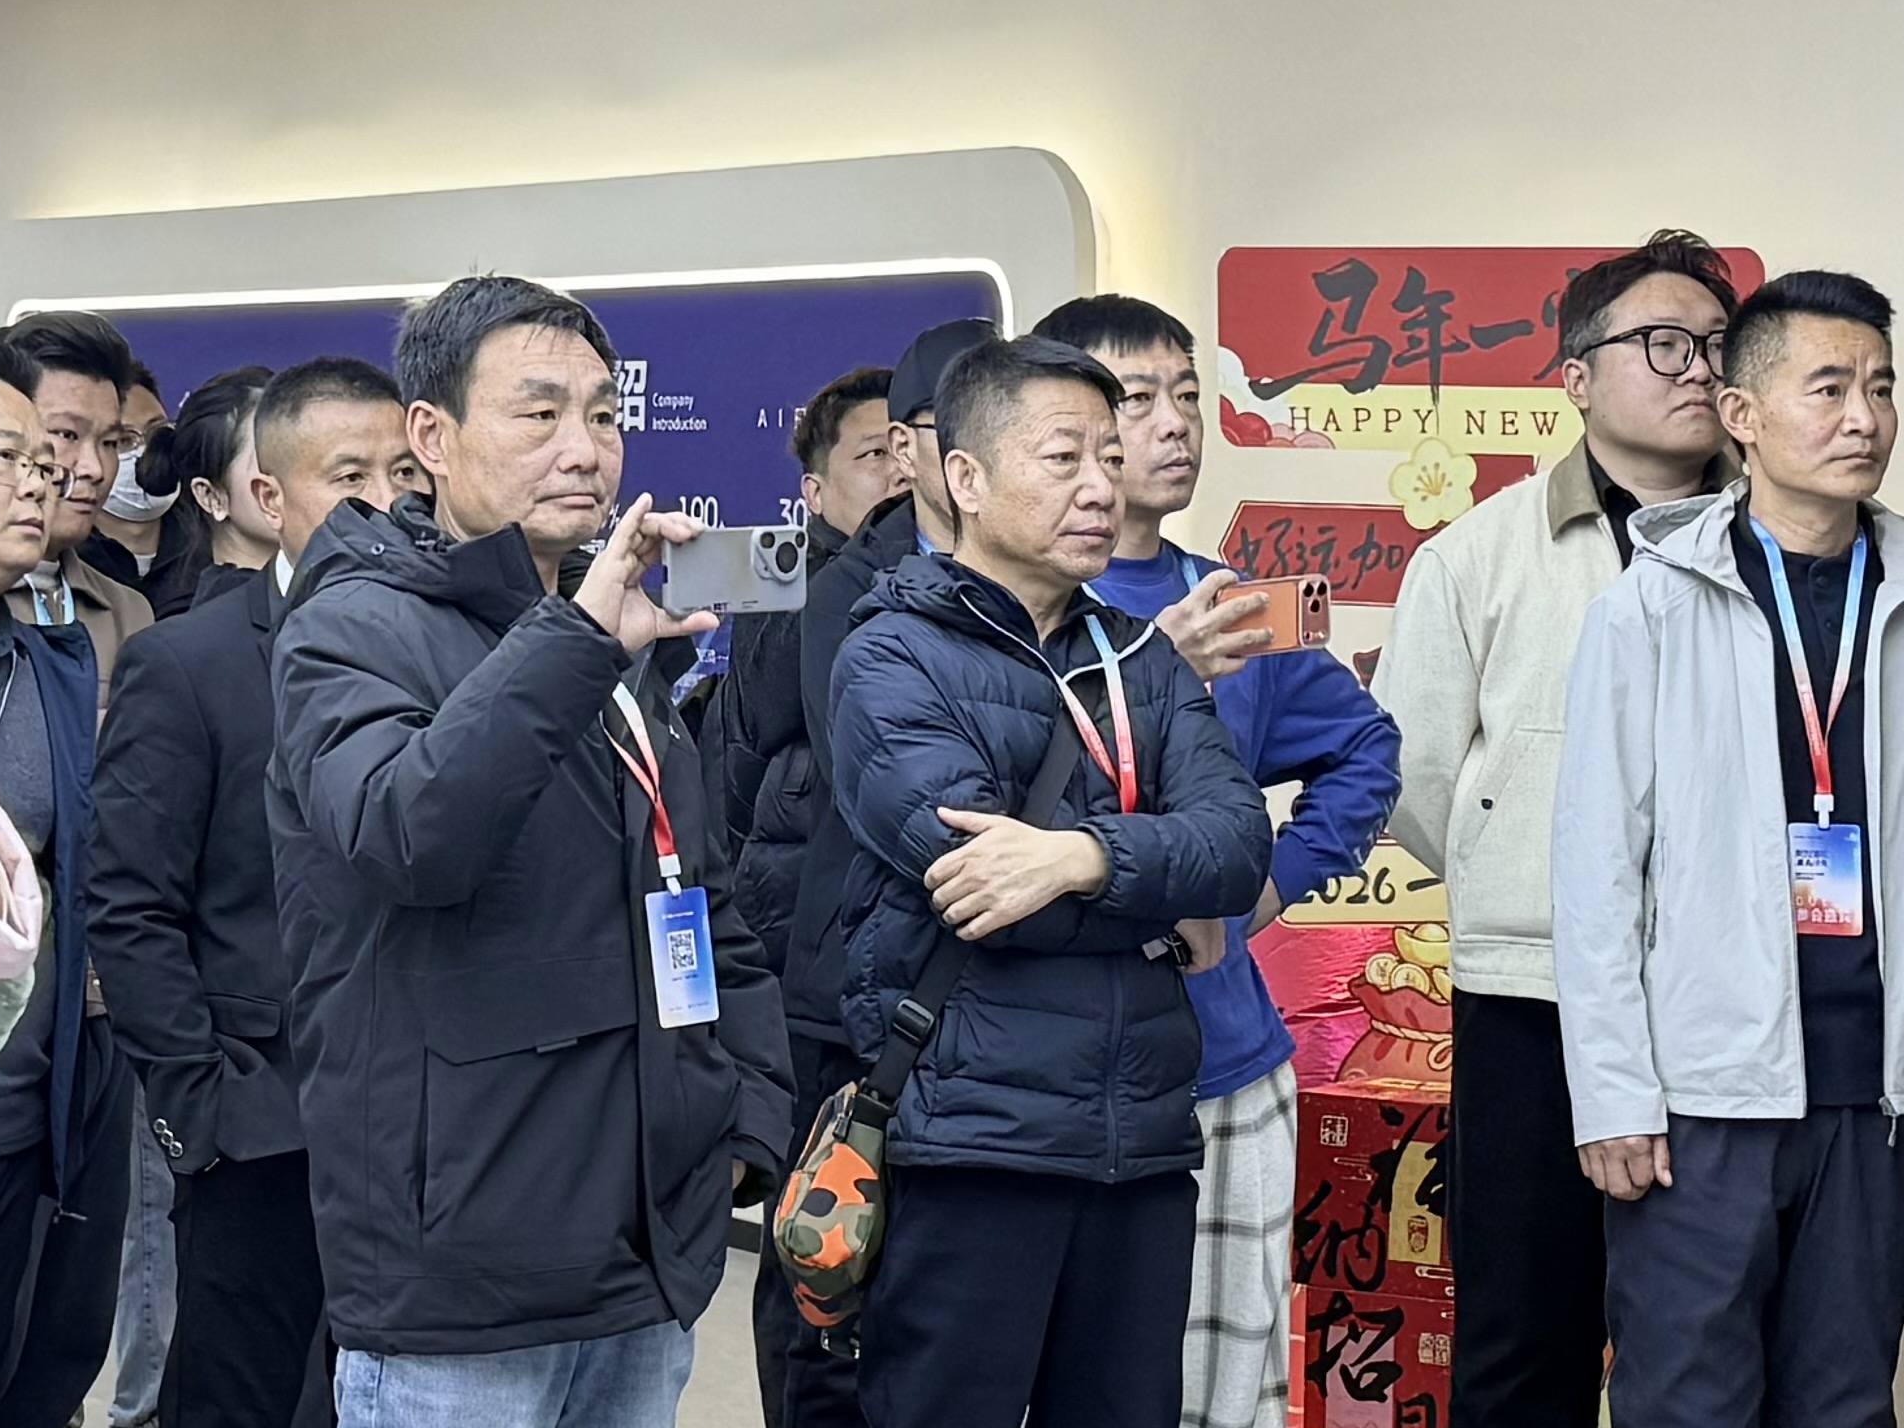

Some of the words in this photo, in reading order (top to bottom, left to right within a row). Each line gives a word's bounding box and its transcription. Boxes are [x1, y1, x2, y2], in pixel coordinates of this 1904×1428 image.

[1249, 257, 1578, 410] 马年一
[652, 392, 695, 411] Company
[652, 415, 708, 431] Introduction
[1288, 406, 1435, 434] HAPPY
[1465, 408, 1561, 437] NEW
